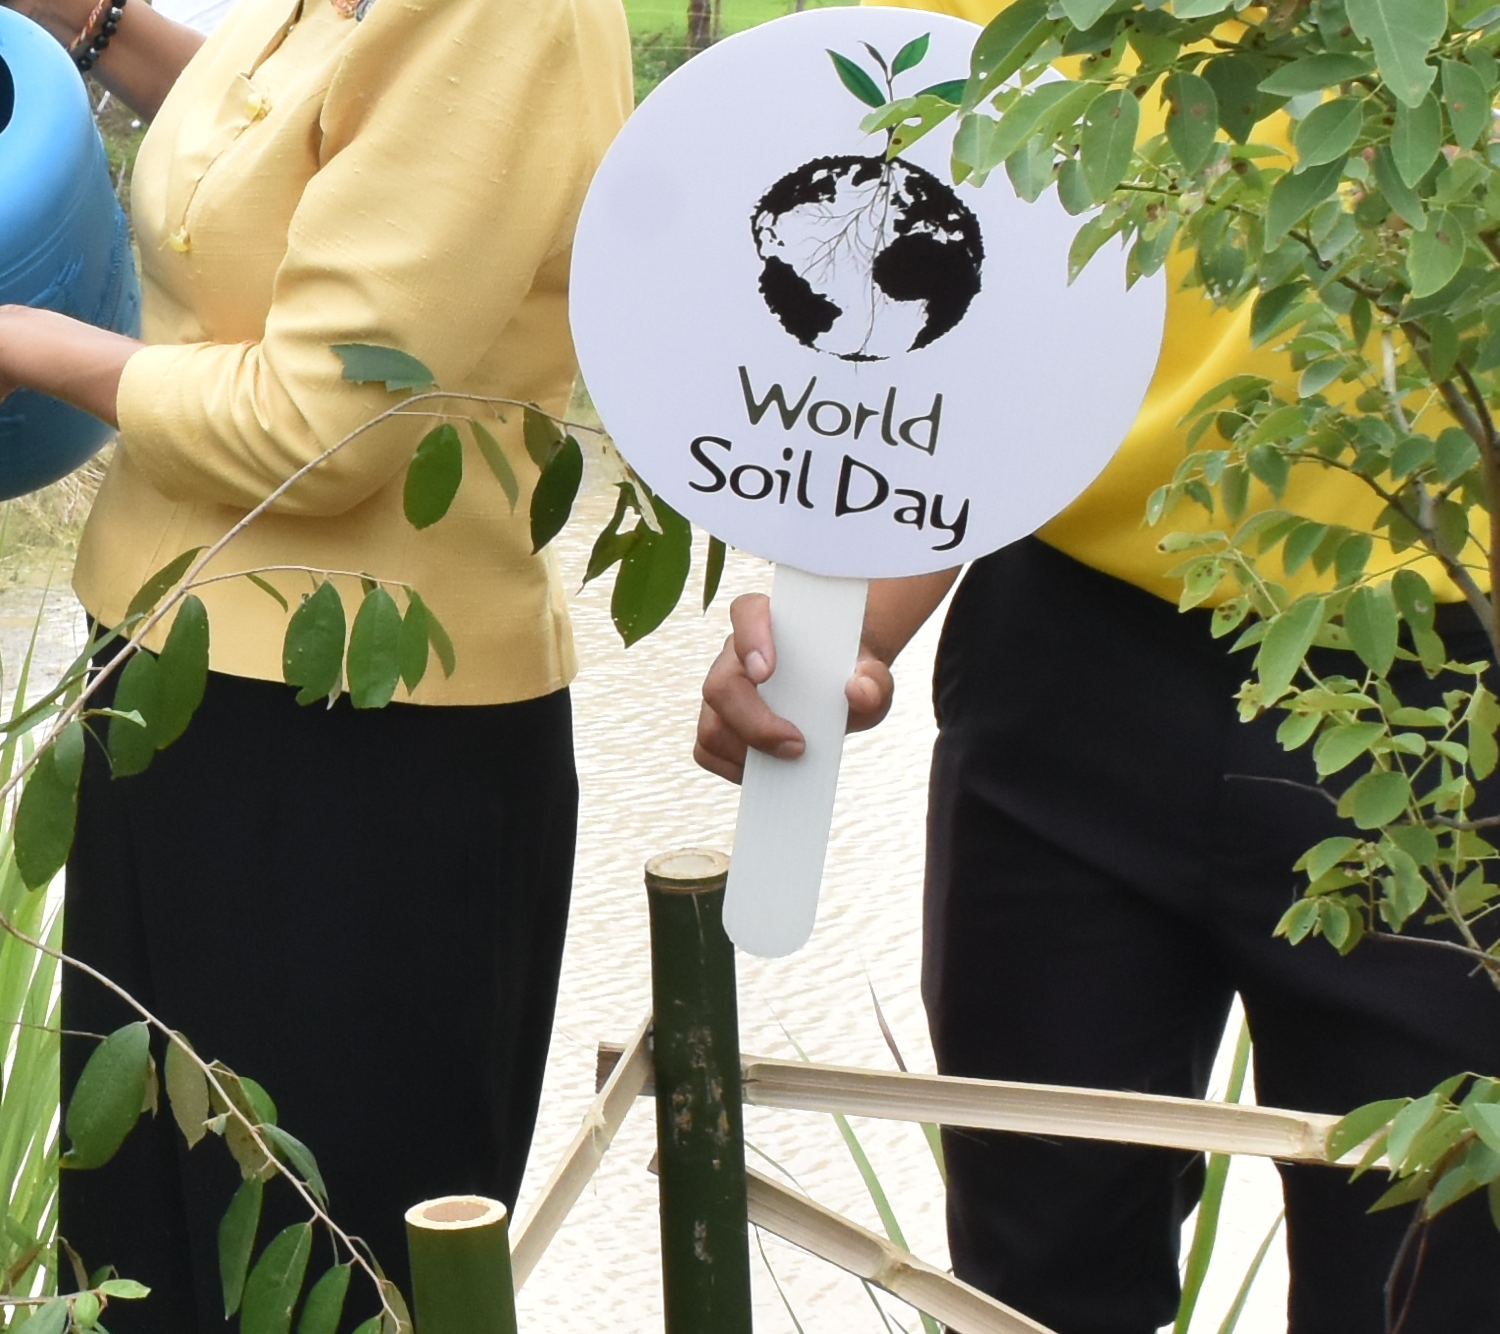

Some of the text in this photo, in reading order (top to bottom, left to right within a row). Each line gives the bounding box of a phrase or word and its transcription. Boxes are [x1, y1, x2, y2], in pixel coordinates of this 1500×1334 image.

[738, 365, 944, 457] World
[687, 435, 970, 552] Soil Day
